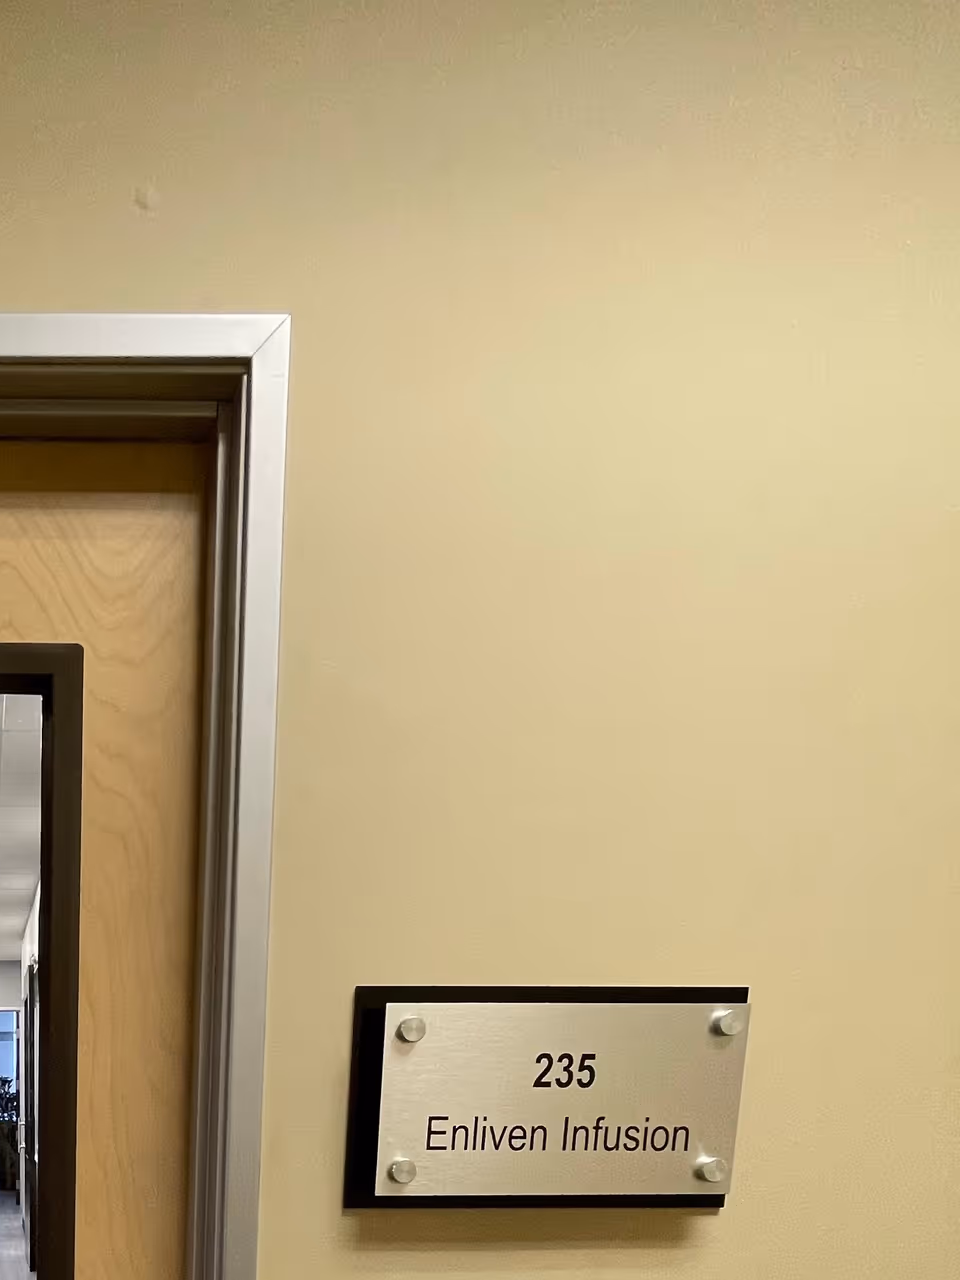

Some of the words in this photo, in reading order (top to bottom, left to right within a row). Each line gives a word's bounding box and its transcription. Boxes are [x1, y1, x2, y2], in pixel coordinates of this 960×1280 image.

[531, 1052, 597, 1089] 235
[425, 1115, 548, 1152] Enliven
[560, 1115, 691, 1152] Infusion
